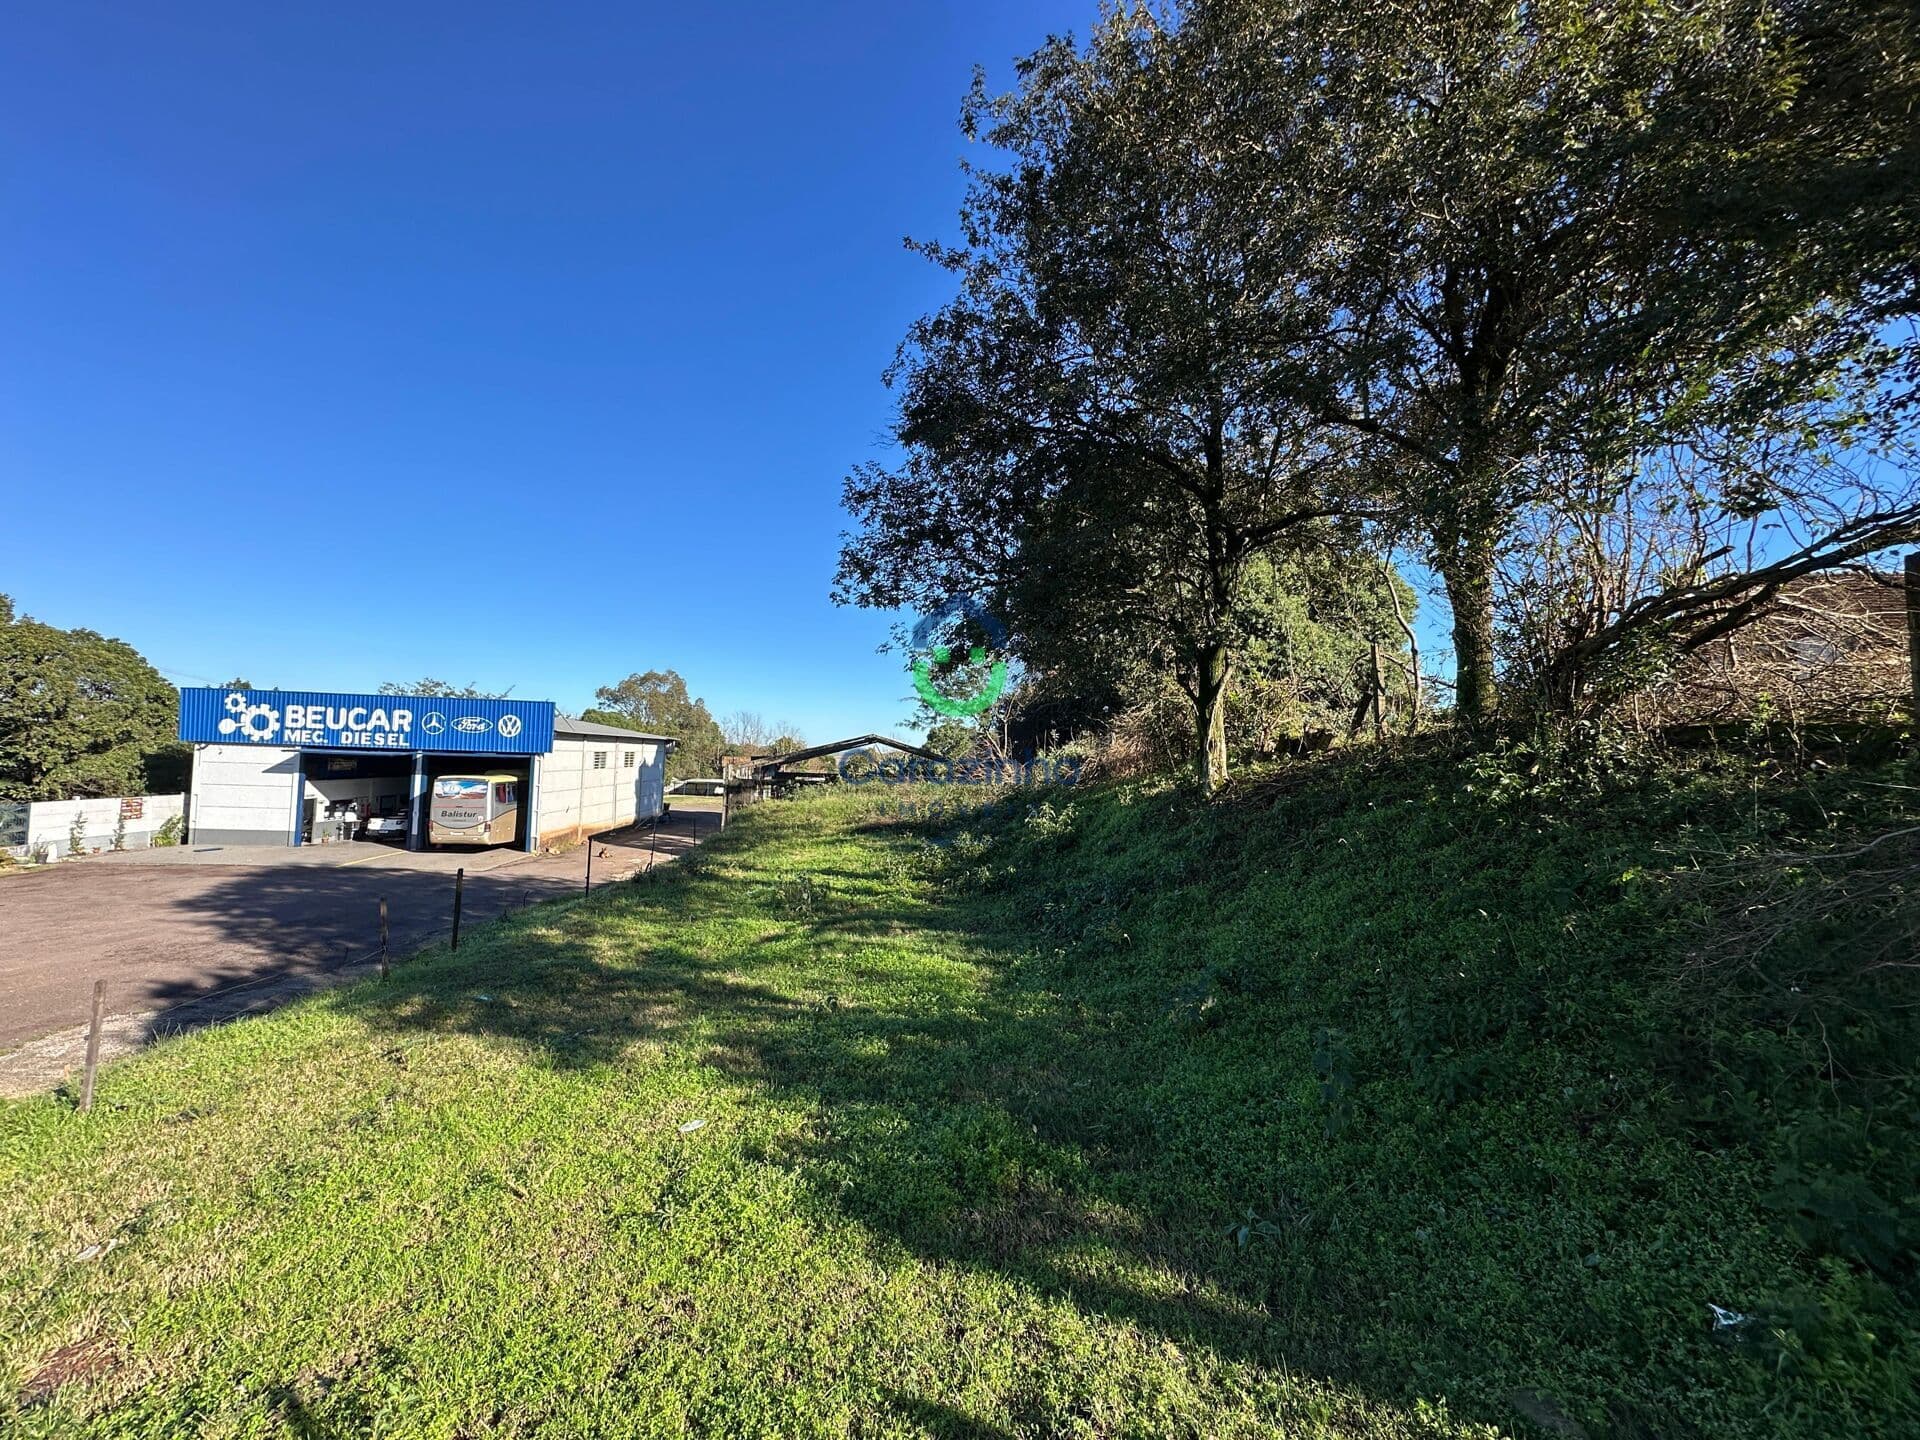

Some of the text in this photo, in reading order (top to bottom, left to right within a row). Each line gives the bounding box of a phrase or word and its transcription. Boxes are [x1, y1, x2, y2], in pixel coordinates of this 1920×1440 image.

[285, 705, 412, 732] BEUCAR
[284, 729, 410, 746] MEC. DIESEL
[441, 810, 477, 818] Balistur
